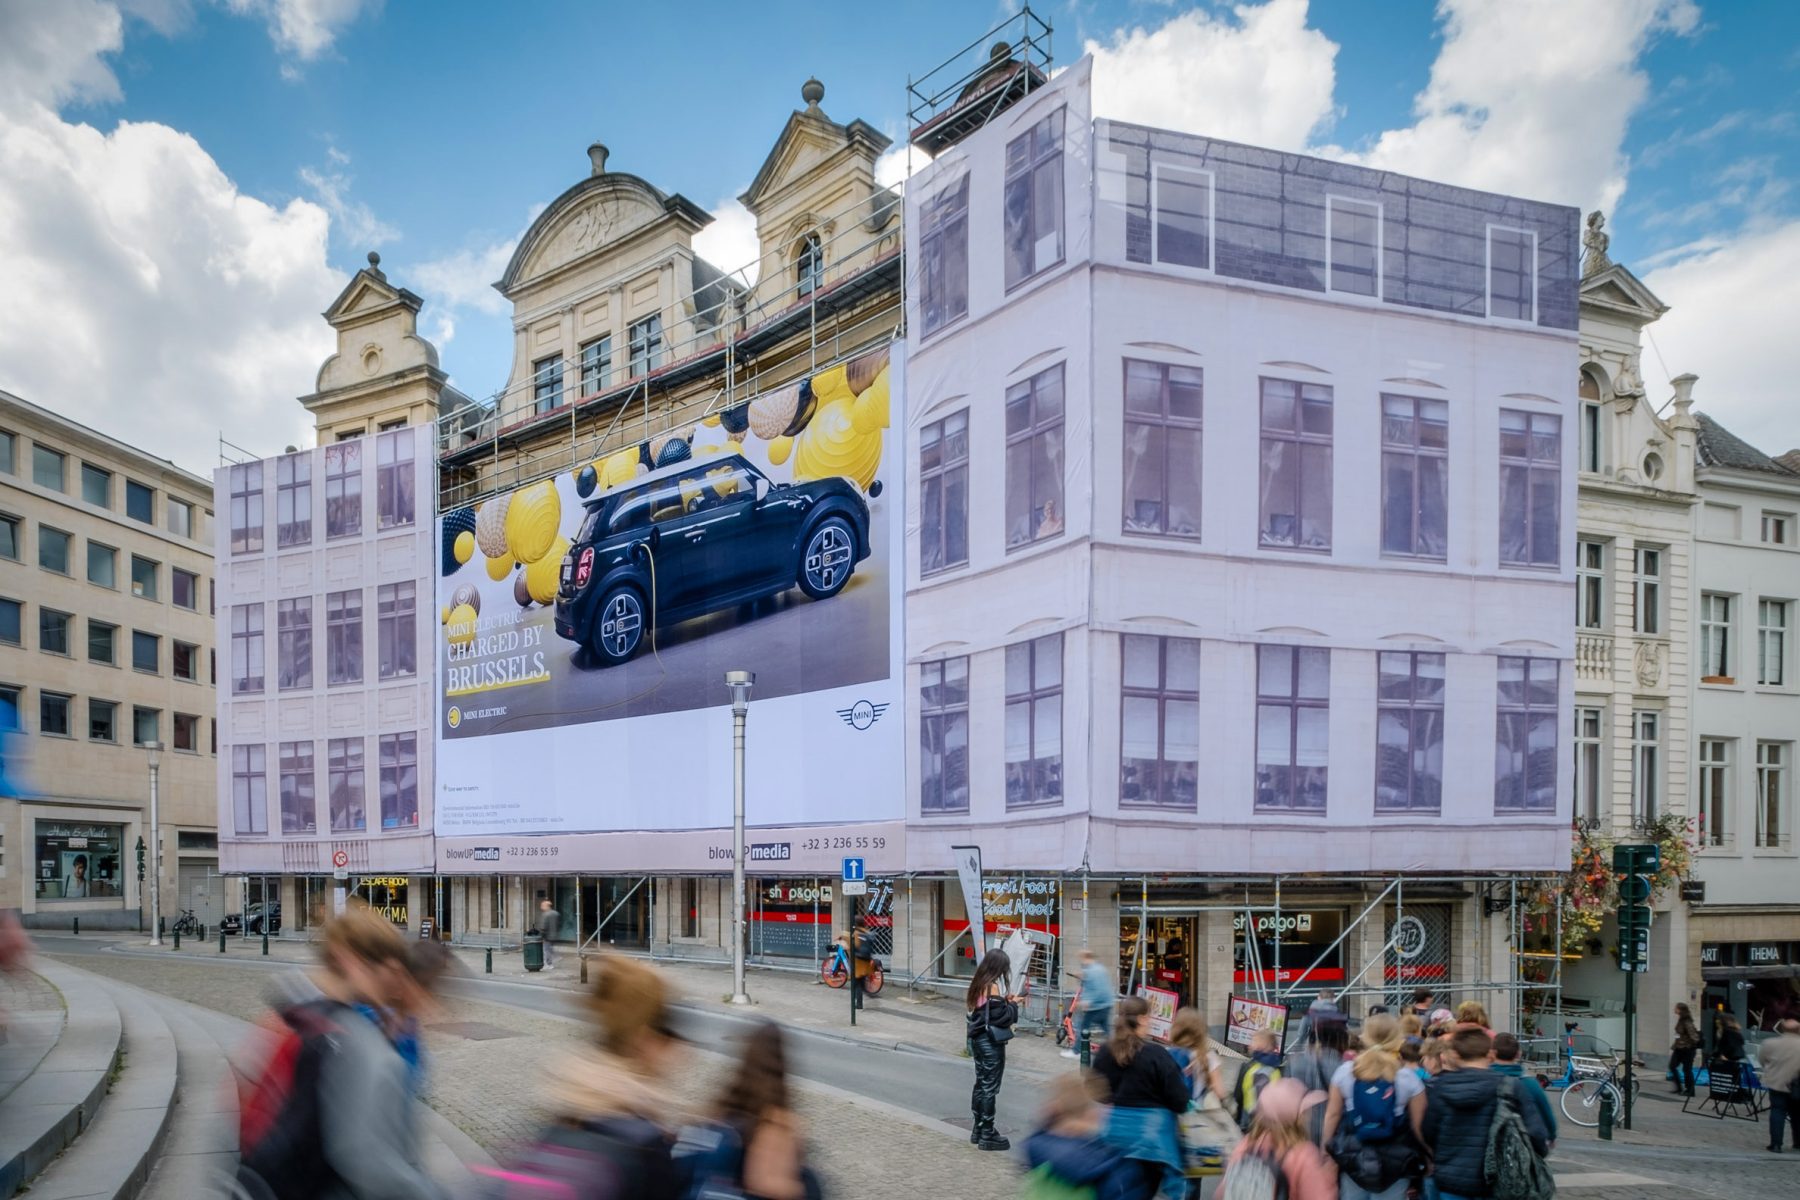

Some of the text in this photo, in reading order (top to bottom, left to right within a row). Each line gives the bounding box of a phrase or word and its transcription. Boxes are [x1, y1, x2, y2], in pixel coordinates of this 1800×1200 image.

[448, 621, 472, 638] MINI
[447, 624, 544, 662] CHARGED BY
[447, 651, 550, 691] BRUSSELS.
[463, 706, 507, 720] MINI ELECTRIC
[853, 710, 872, 720] MINI
[801, 838, 820, 850] +32
[823, 838, 830, 849] 3
[833, 837, 852, 849] 236
[856, 837, 868, 848] 55
[872, 837, 886, 849] 59
[506, 847, 518, 856] +32
[520, 847, 525, 856] 3
[526, 847, 539, 856] 236
[540, 847, 549, 856] 55
[550, 847, 559, 856] 59
